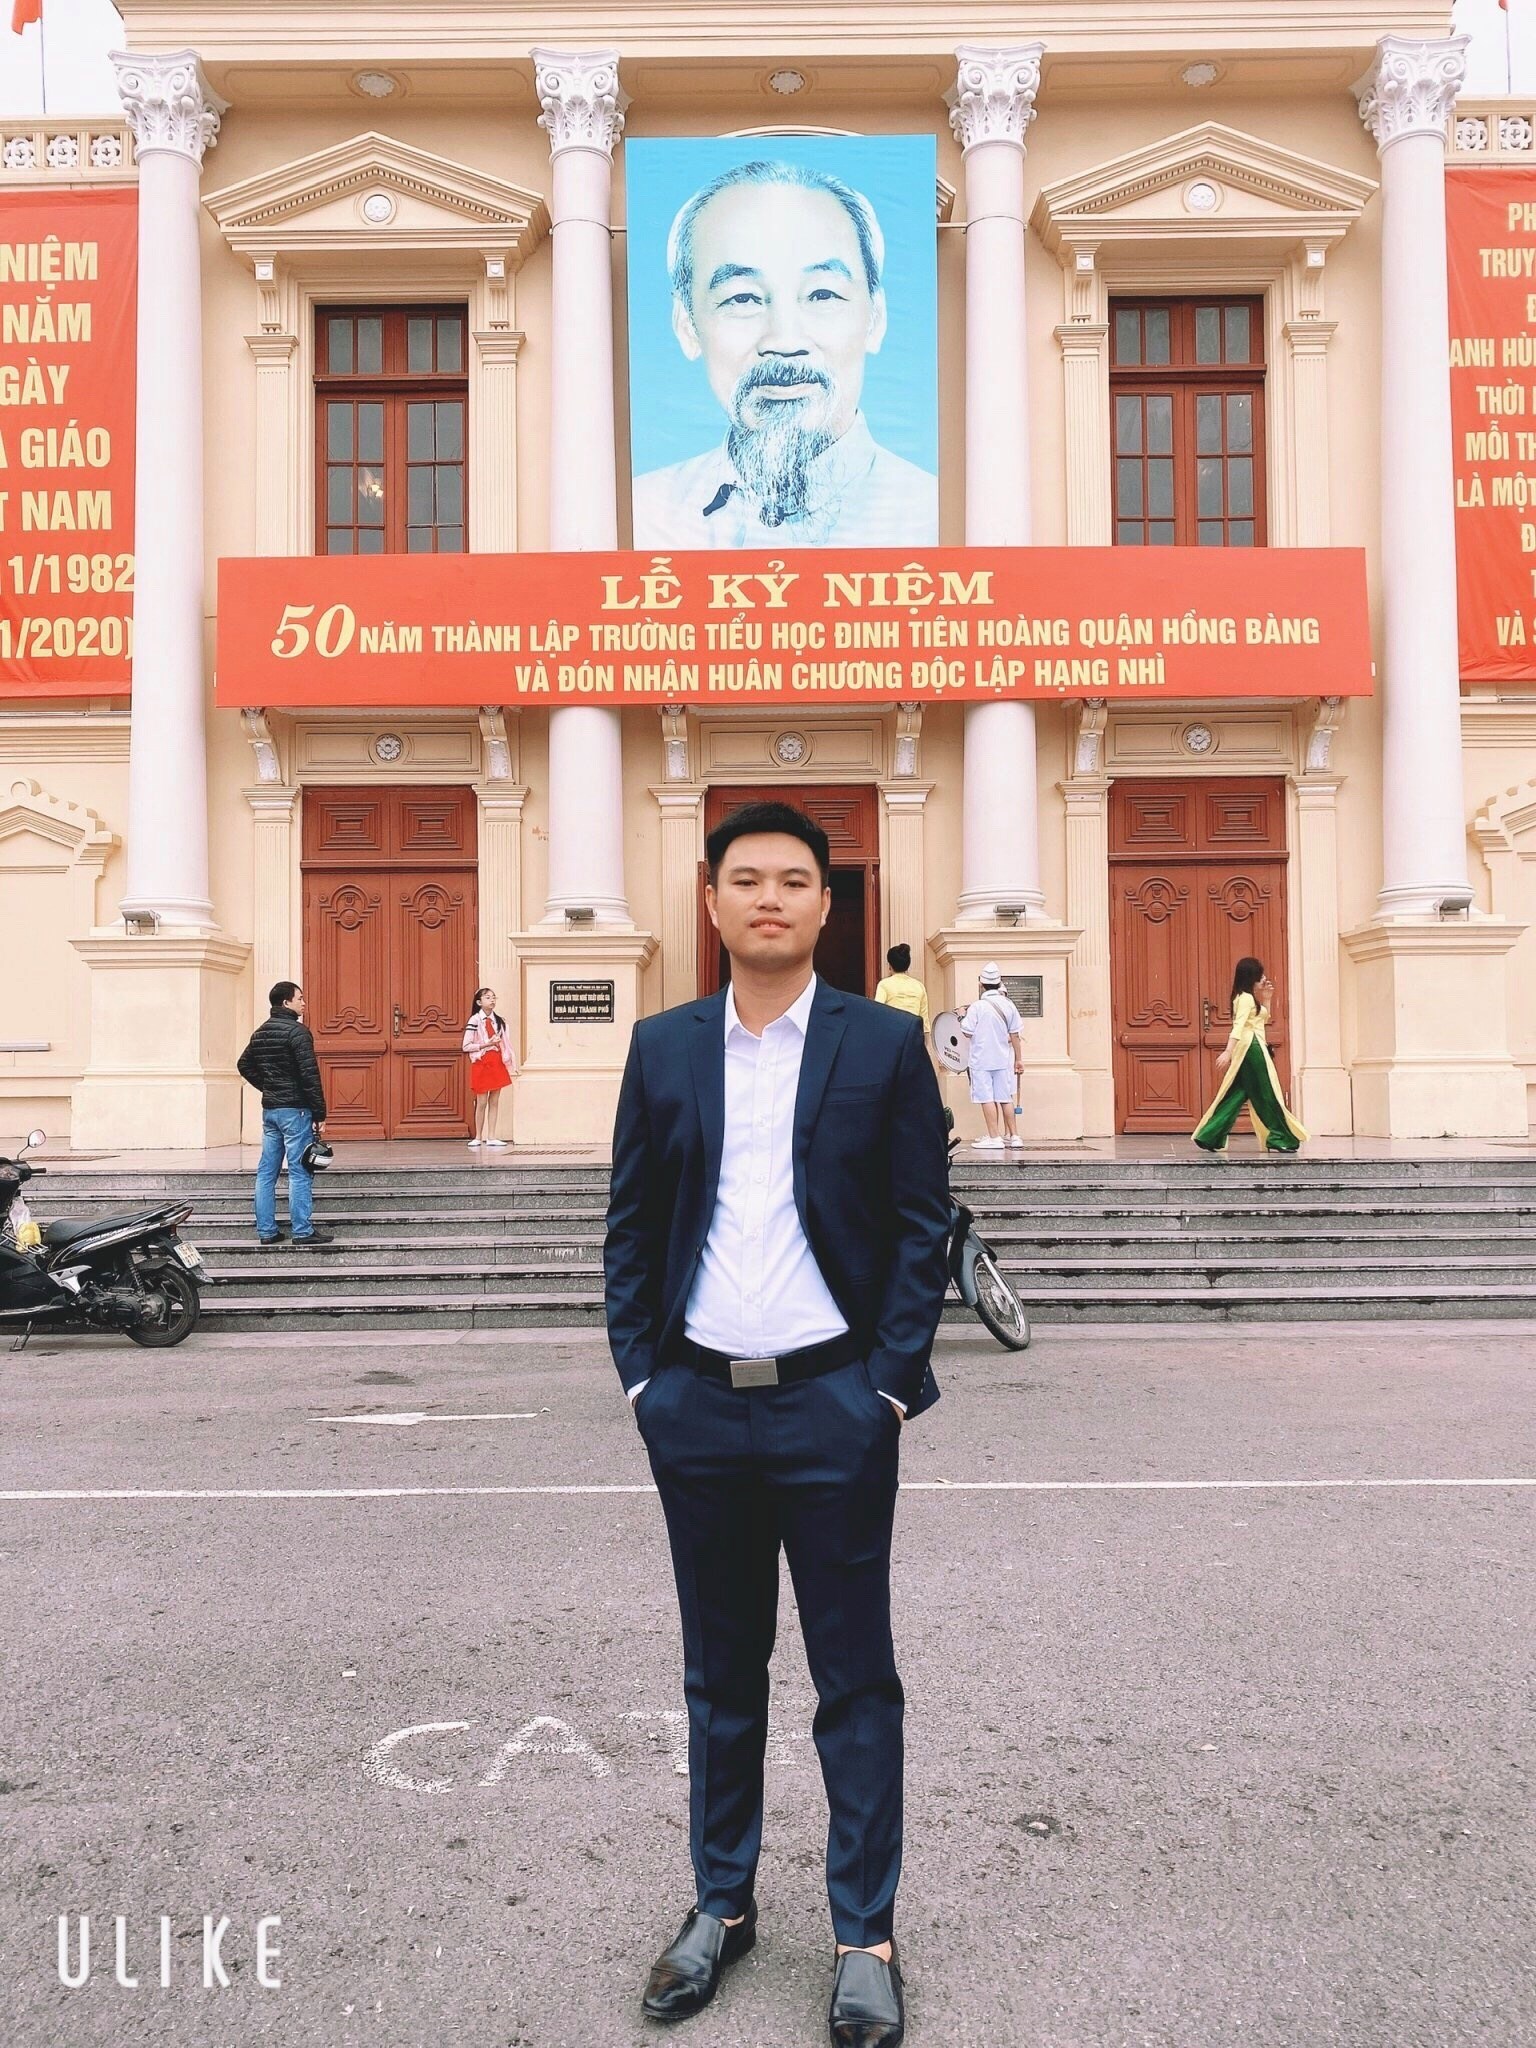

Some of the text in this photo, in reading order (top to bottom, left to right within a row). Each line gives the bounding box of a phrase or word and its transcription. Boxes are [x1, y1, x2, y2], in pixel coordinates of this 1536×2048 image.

[0, 235, 97, 290] NIỆM
[1479, 248, 1536, 277] TRUY
[3, 296, 91, 343] NĂM
[1450, 332, 1536, 367] ANH HÙ
[1476, 379, 1524, 415] THỜI
[21, 420, 110, 468] GIÁO
[1466, 420, 1509, 461] MỖI
[22, 491, 111, 531] NAM
[1457, 472, 1536, 513] LÀ MỘT
[0, 554, 135, 595] 1/1982
[601, 557, 994, 615] LỄ KỶ NIỆM
[270, 604, 1319, 659] 50 NĂM THÀNH LẬP TRƯỜNG TIỂU HỌC ĐINH TIÊN HOÀNG QUẬN HỒNG BÀNG
[1497, 610, 1525, 645] VÀ
[515, 652, 1165, 697] VÀ ĐÓN NHẬN HUÂN CHƯƠNG ĐỘC LẬP HẠNG NHÌ
